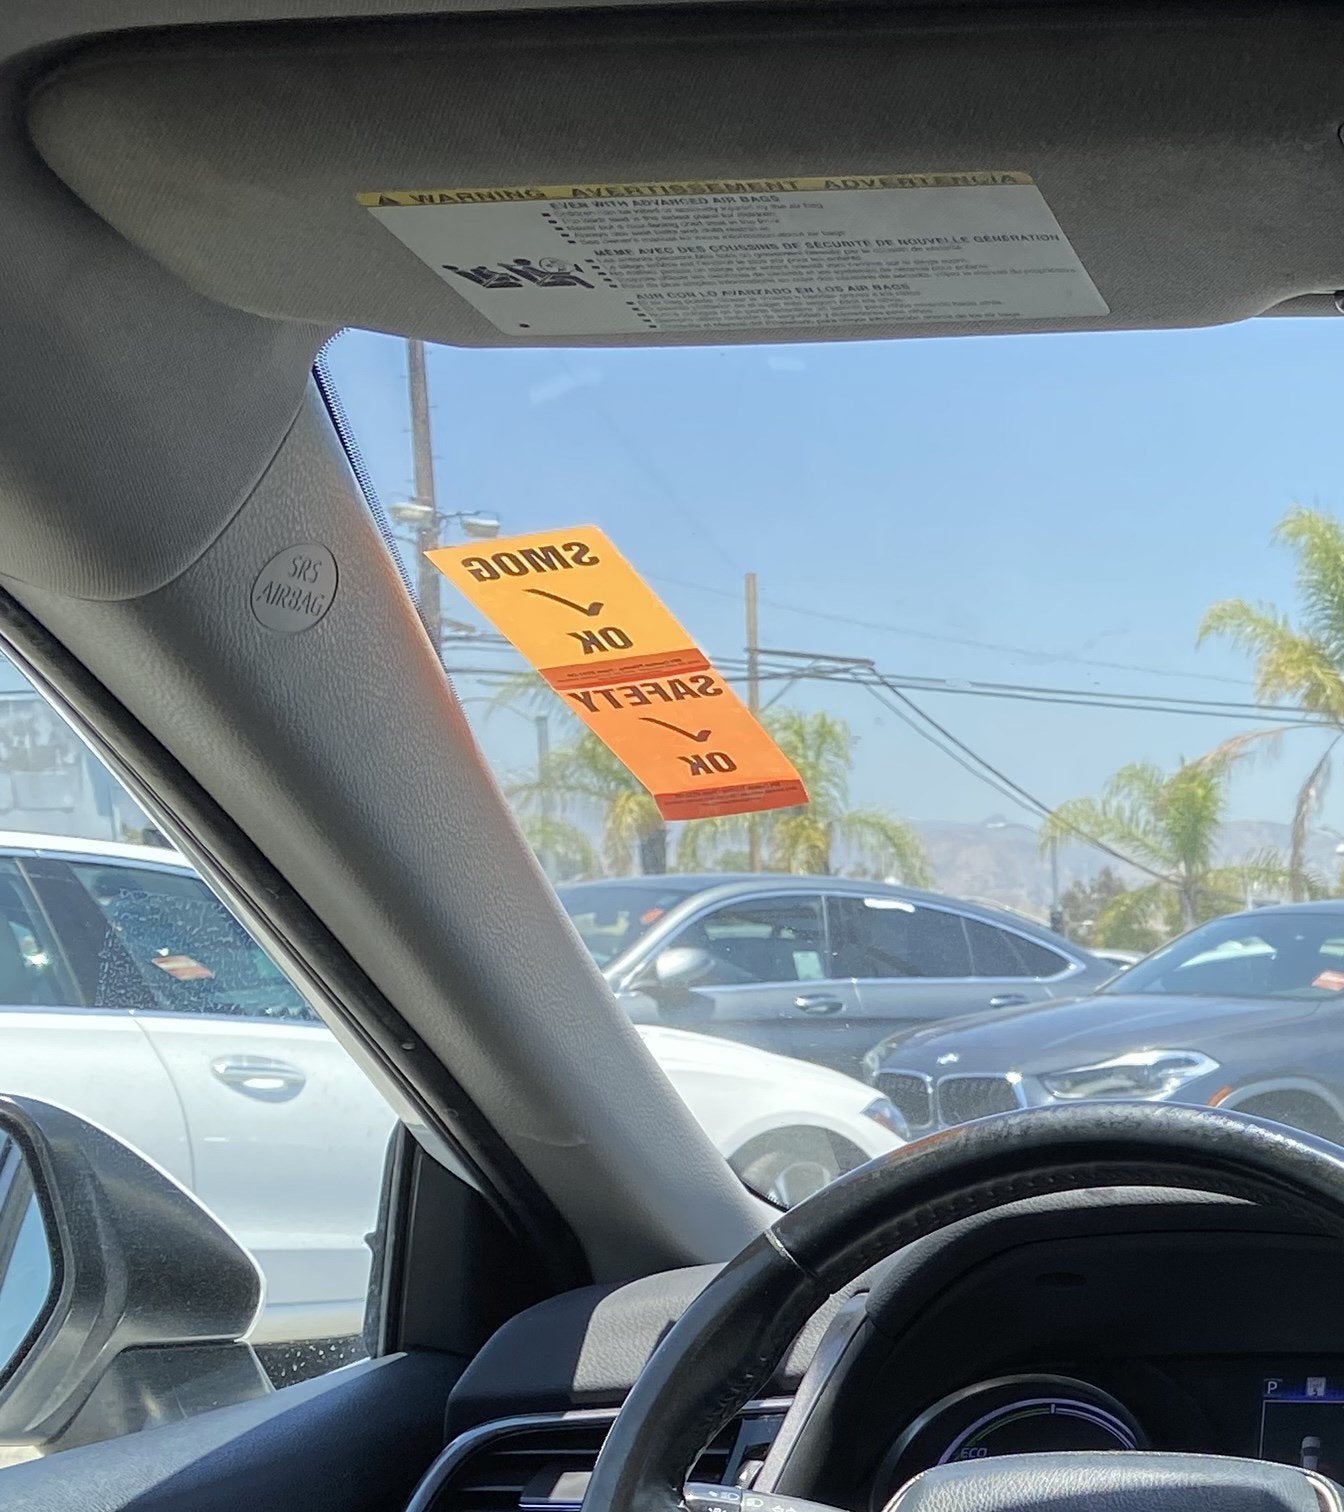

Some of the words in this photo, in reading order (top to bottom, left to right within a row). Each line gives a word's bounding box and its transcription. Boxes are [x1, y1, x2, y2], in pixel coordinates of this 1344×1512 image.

[408, 188, 547, 205] WARNING
[632, 197, 709, 207] ADVANCED
[713, 195, 737, 204] AIR
[287, 555, 322, 584] SRS
[255, 580, 325, 617] AIRBAG
[1267, 1381, 1278, 1395] P
[960, 1446, 987, 1458] ECO
